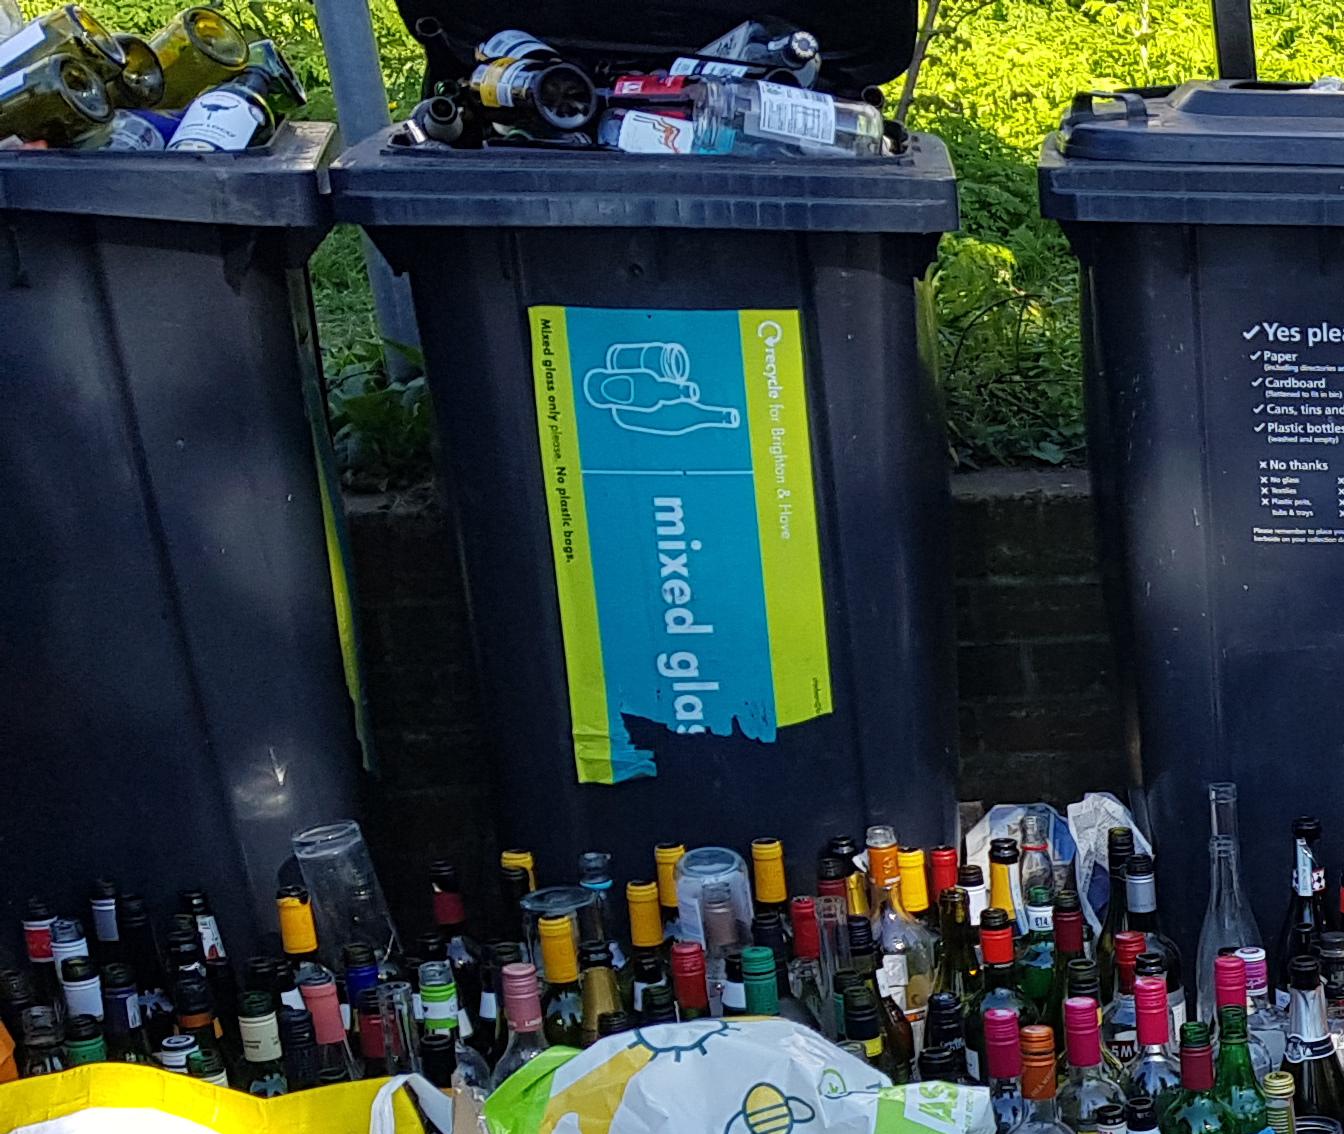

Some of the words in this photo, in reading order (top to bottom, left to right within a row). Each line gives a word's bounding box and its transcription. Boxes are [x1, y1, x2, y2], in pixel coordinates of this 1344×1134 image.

[539, 318, 554, 356] Mixed
[1262, 322, 1301, 342] Yes
[1264, 351, 1298, 363] Paper
[542, 357, 557, 393] glass
[763, 347, 783, 400] recycle
[1265, 378, 1326, 388] Cardboard
[546, 394, 559, 422] only
[769, 402, 785, 421] for
[1267, 404, 1298, 416] Cans,
[1301, 404, 1322, 415] tins
[1268, 423, 1305, 434] Plastic
[769, 426, 787, 488] Brighton
[1270, 460, 1287, 470] No
[1289, 460, 1329, 471] thanks
[556, 465, 567, 483] No
[557, 485, 572, 529] plastic
[779, 504, 793, 540] Hove
[654, 497, 714, 634] mixed
